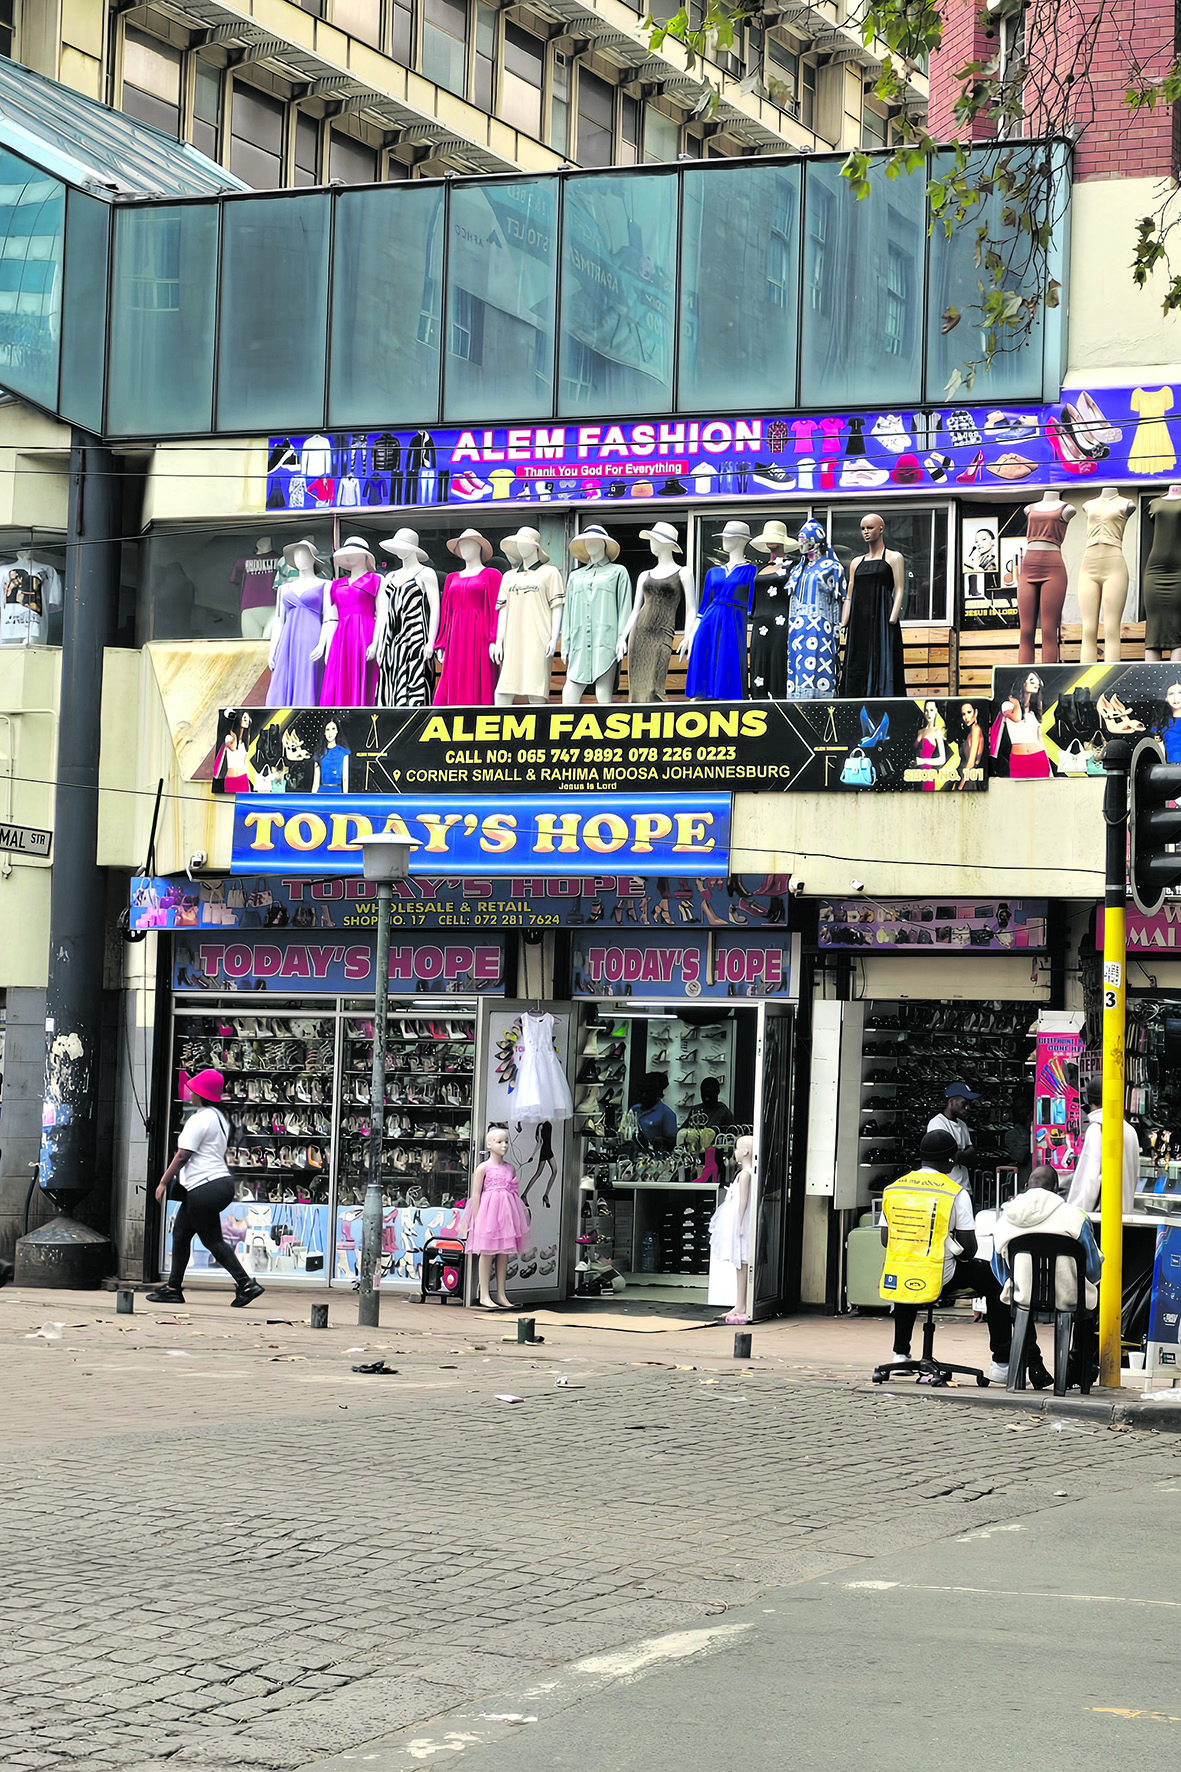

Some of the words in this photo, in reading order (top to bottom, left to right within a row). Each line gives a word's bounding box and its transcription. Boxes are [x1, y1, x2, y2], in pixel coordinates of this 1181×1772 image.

[450, 428, 565, 462] ALEM
[578, 420, 762, 459] FASHION
[524, 466, 556, 476] Thank
[558, 466, 578, 477] You
[580, 465, 603, 476] God
[605, 464, 624, 475] For
[625, 462, 682, 476] Everything
[419, 714, 537, 742] ALEM
[549, 710, 768, 741] FASHIONS
[445, 750, 483, 764] CALL
[486, 749, 513, 763] NO:
[517, 749, 546, 763] 065
[550, 748, 580, 763] 747
[584, 748, 623, 762] 9892
[628, 748, 658, 762] 078
[662, 747, 692, 761] 226
[697, 746, 737, 761] 0223
[405, 768, 471, 783] CORNER
[474, 768, 522, 782] SMALL
[526, 768, 538, 782] &
[540, 767, 599, 781] RAHIMA
[602, 766, 659, 781] MOOSA
[662, 764, 790, 780] JOHANNESBURG
[903, 767, 939, 782] SHOP
[30, 833, 46, 846] STR
[244, 811, 517, 853] TODAY'S
[532, 812, 716, 853] HOPE
[510, 876, 647, 898] HOPE
[459, 902, 471, 912] &
[477, 901, 531, 912] RETAIL
[343, 916, 378, 926] SHOP
[411, 915, 426, 925] 17
[438, 915, 471, 925] CELL:
[475, 915, 498, 925] 072
[502, 914, 523, 925] 281
[530, 914, 560, 925] 7624
[200, 943, 371, 980] TODAY'S
[388, 945, 500, 979] HOPE
[589, 947, 700, 982] TODAY'S
[714, 948, 783, 983] HOPE
[1105, 991, 1116, 1008] 3
